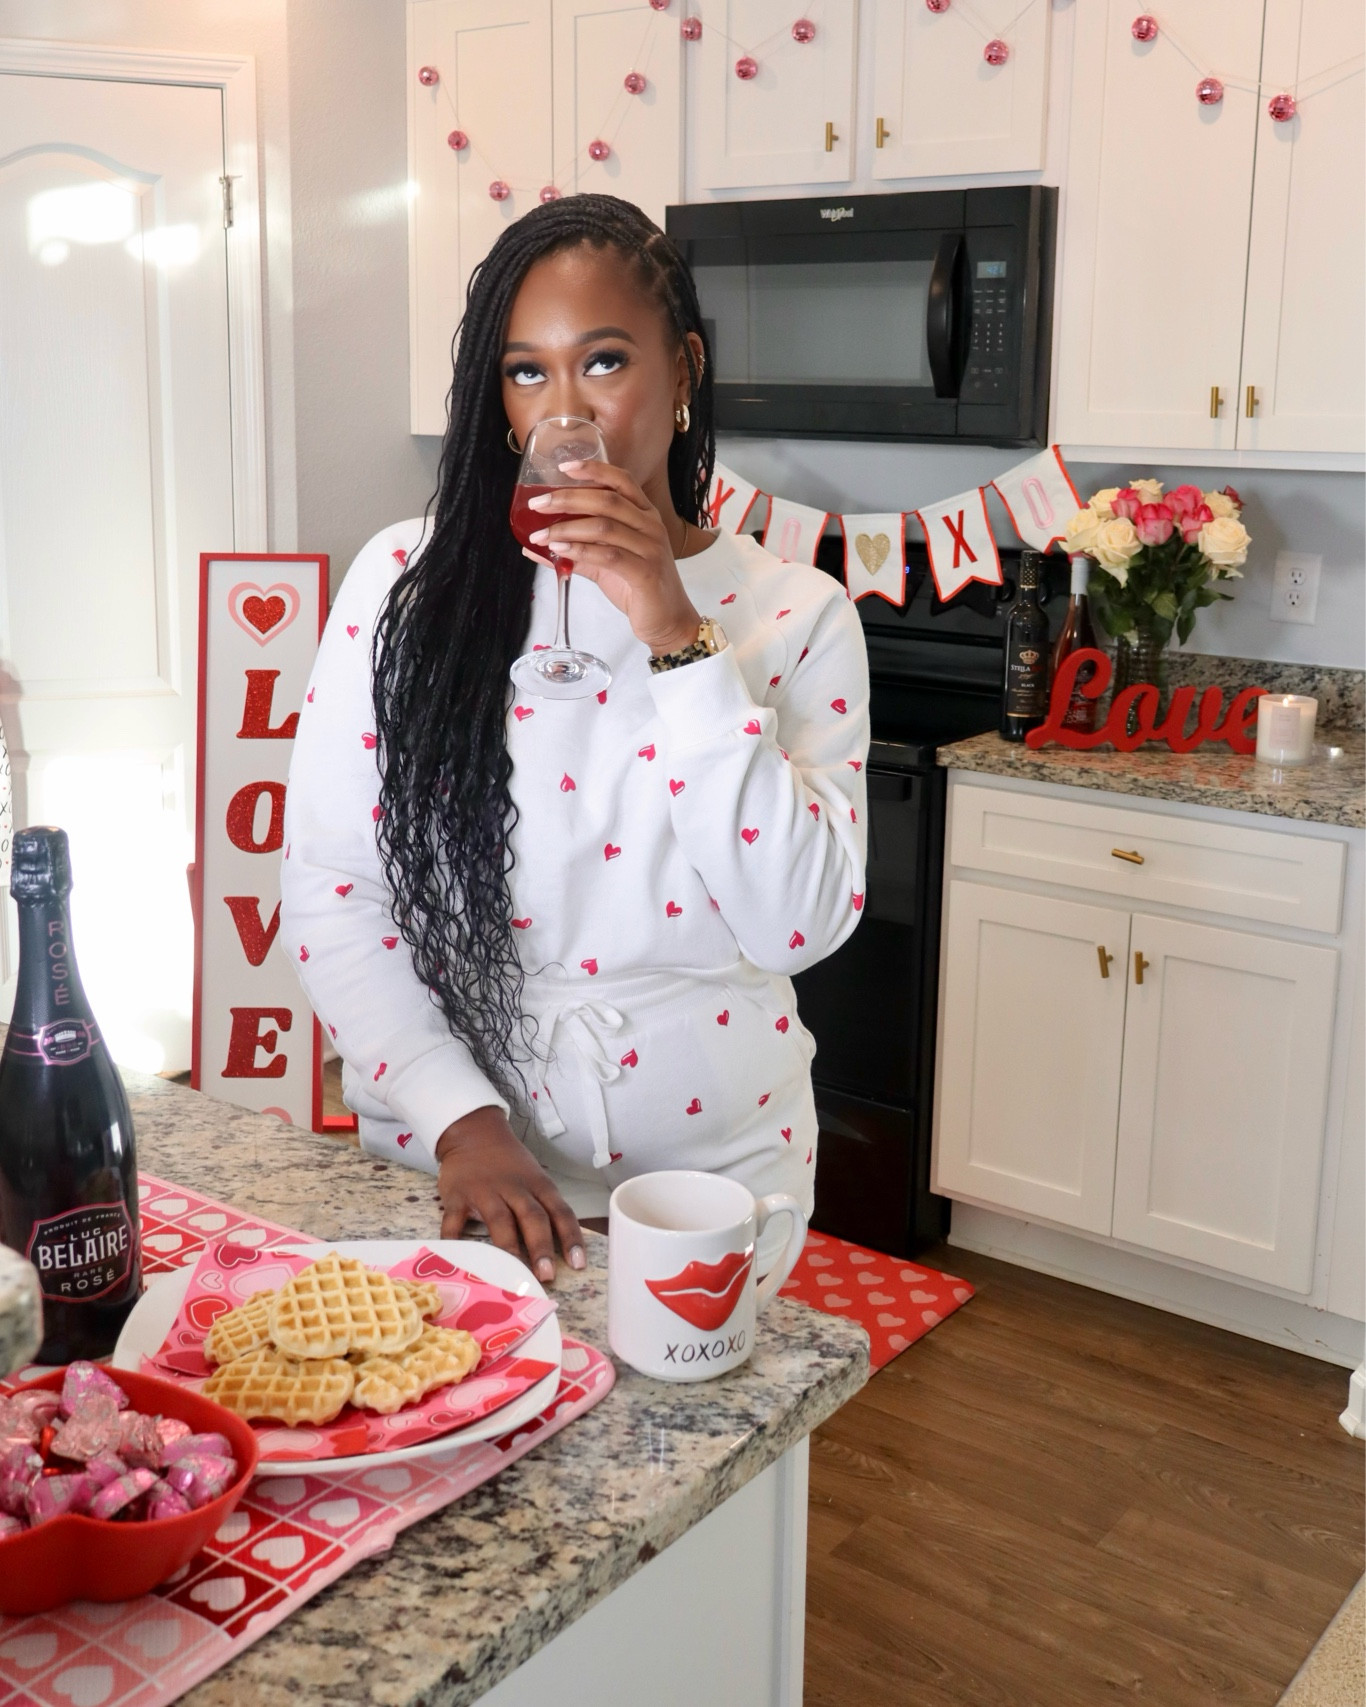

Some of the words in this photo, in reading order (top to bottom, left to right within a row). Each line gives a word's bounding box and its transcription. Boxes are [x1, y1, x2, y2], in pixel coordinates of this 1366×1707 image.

[942, 510, 978, 568] X
[1025, 648, 1268, 754] Love
[48, 920, 71, 1006] ROSÉ
[43, 1219, 78, 1236] PRODUIT
[70, 1227, 101, 1241] LUC
[37, 1224, 127, 1270] BELAIRE
[61, 1268, 115, 1293] ROSÉ
[73, 1266, 103, 1279] RARE
[663, 1329, 746, 1364] XOXOXO
